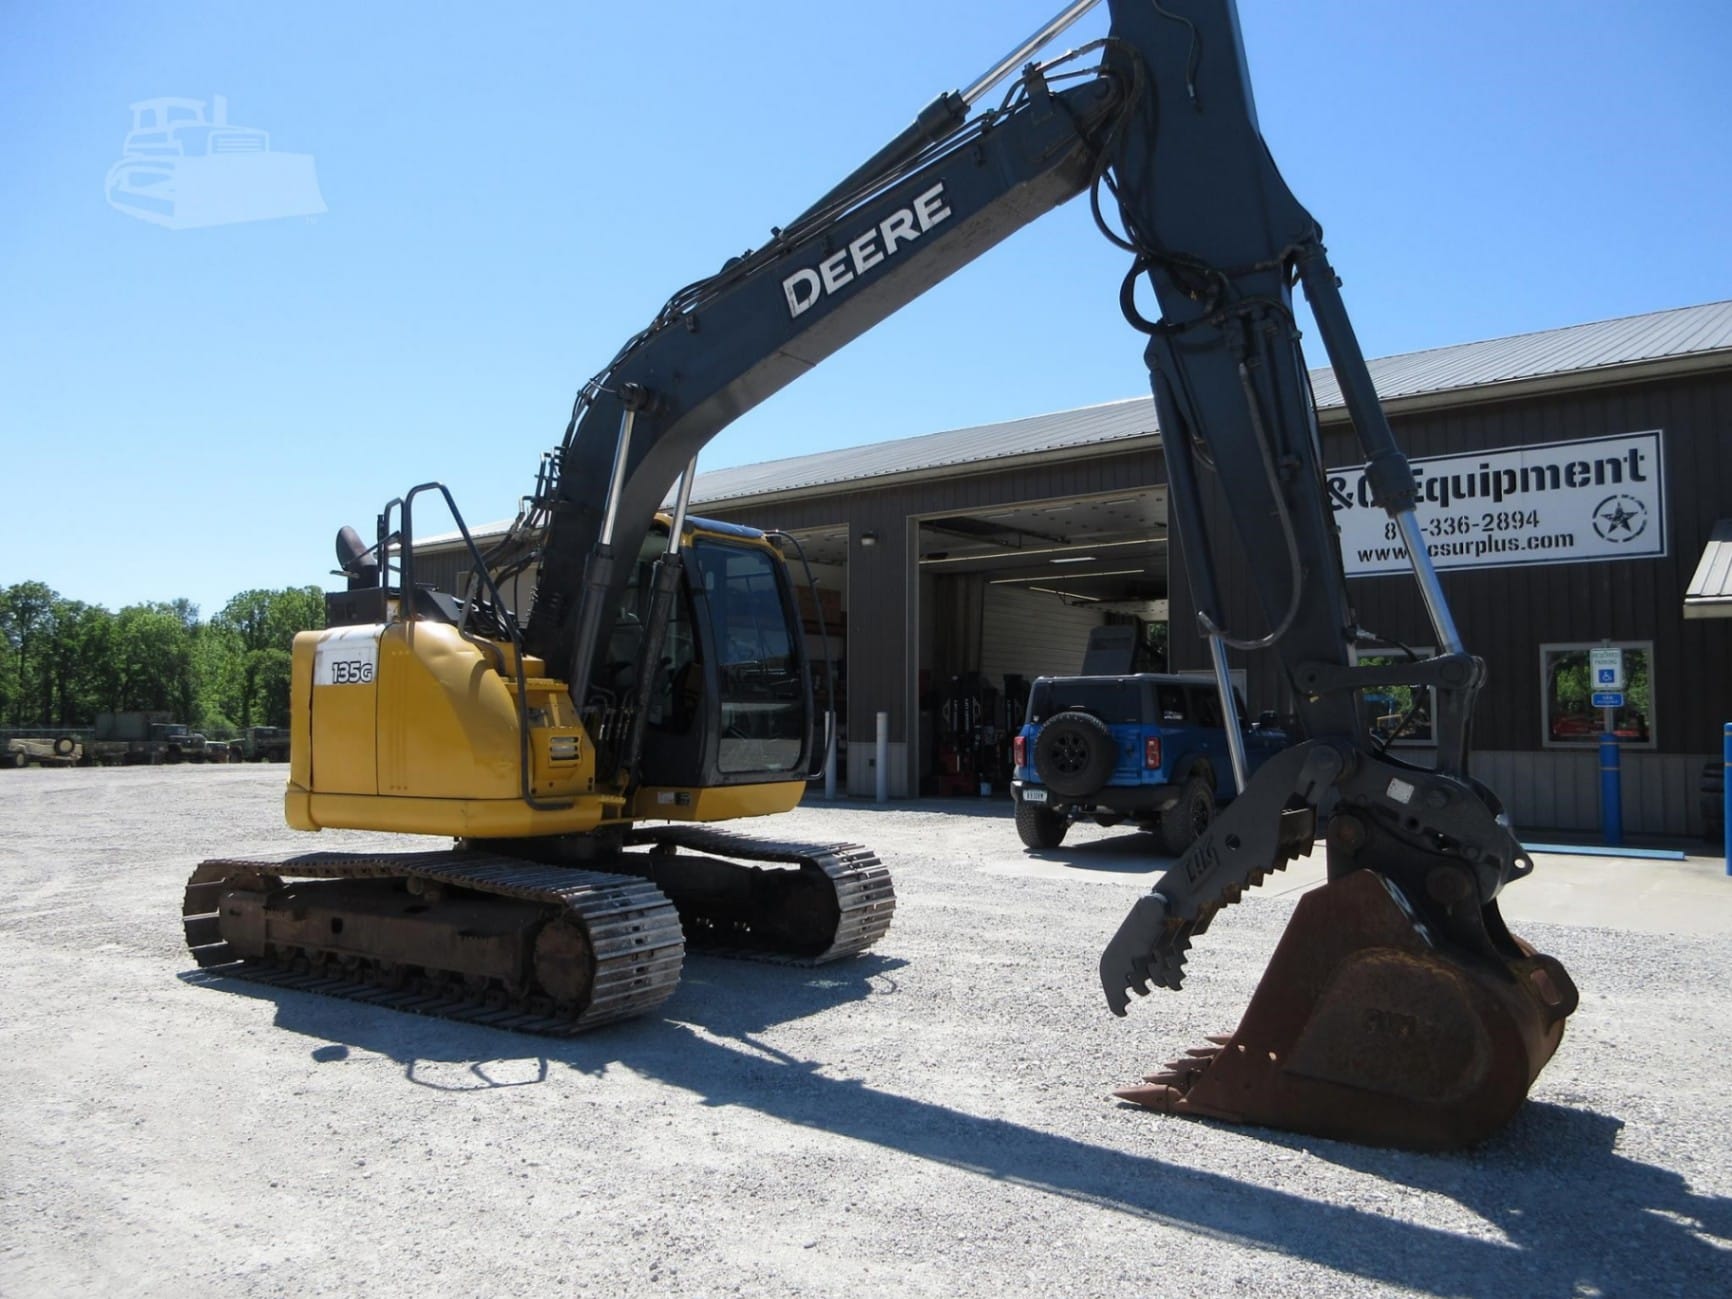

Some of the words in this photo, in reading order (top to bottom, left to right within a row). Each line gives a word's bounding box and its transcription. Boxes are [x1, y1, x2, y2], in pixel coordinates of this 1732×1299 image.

[782, 182, 951, 318] DEERE
[1384, 509, 1540, 541] 8-336-2894
[1357, 532, 1575, 562] wwwcsurplus.com
[332, 661, 373, 684] 135G
